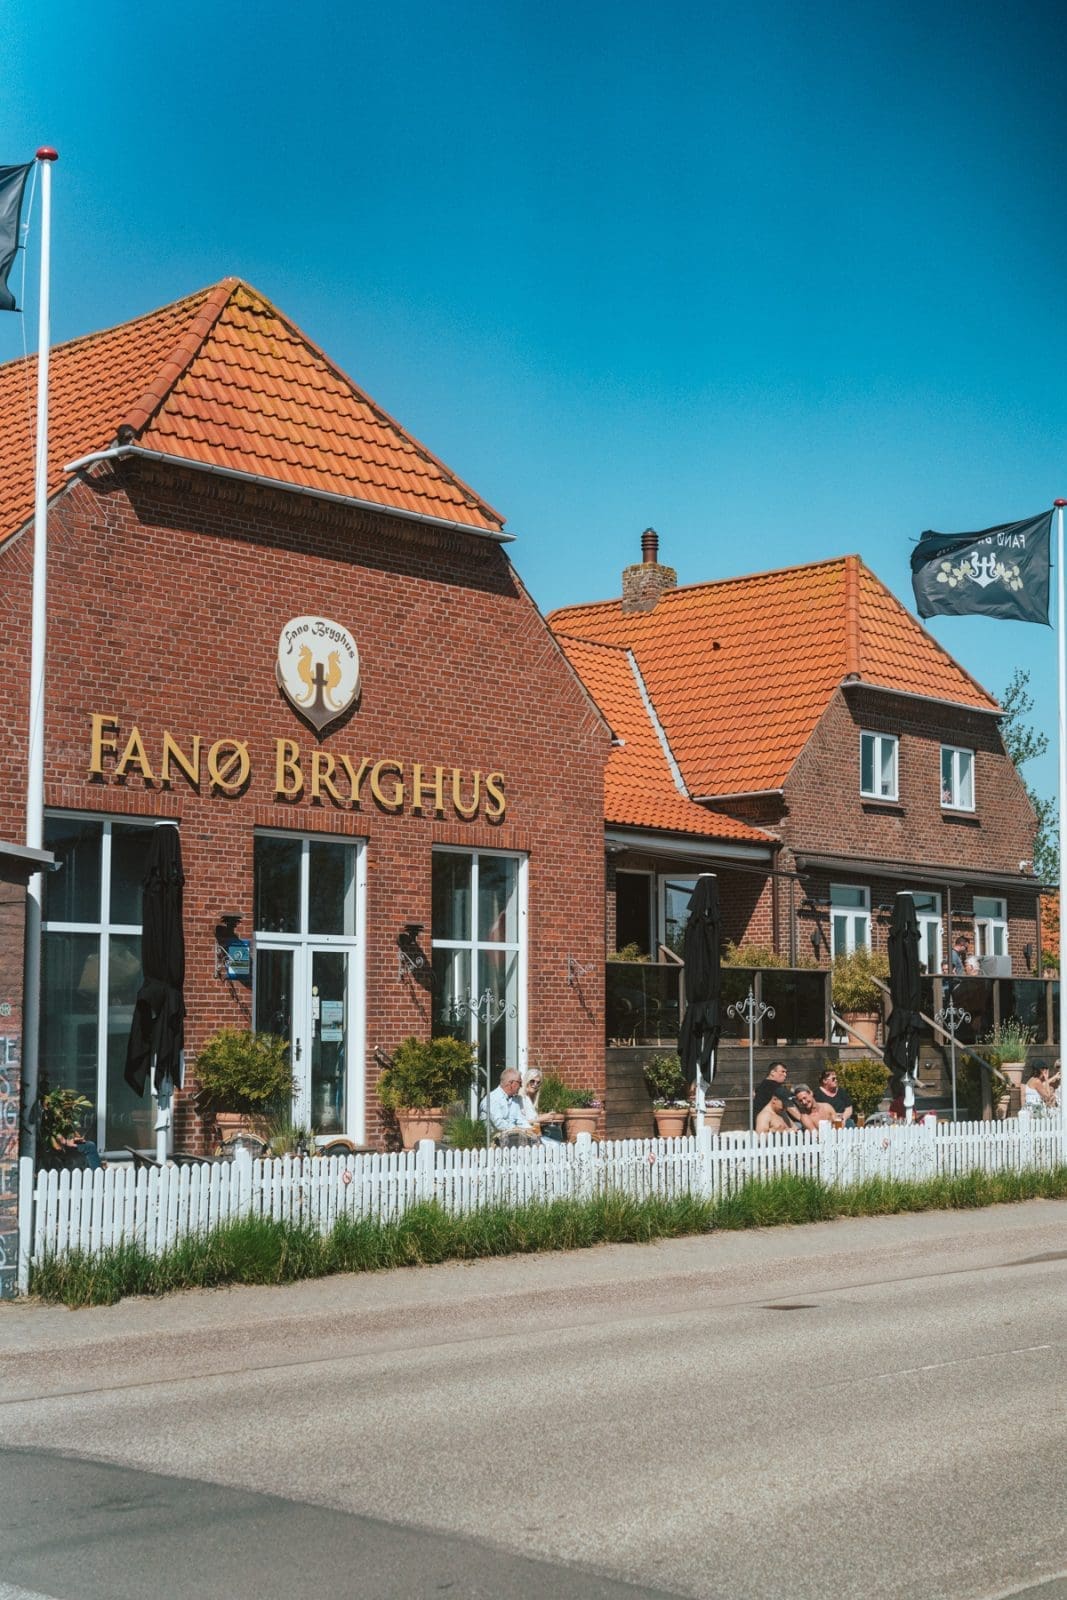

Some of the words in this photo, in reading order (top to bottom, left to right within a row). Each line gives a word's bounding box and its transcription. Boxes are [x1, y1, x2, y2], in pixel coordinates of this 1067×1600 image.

[311, 621, 355, 659] Bryghus
[87, 712, 250, 789] FANØ
[273, 737, 506, 816] BRYGHUS
